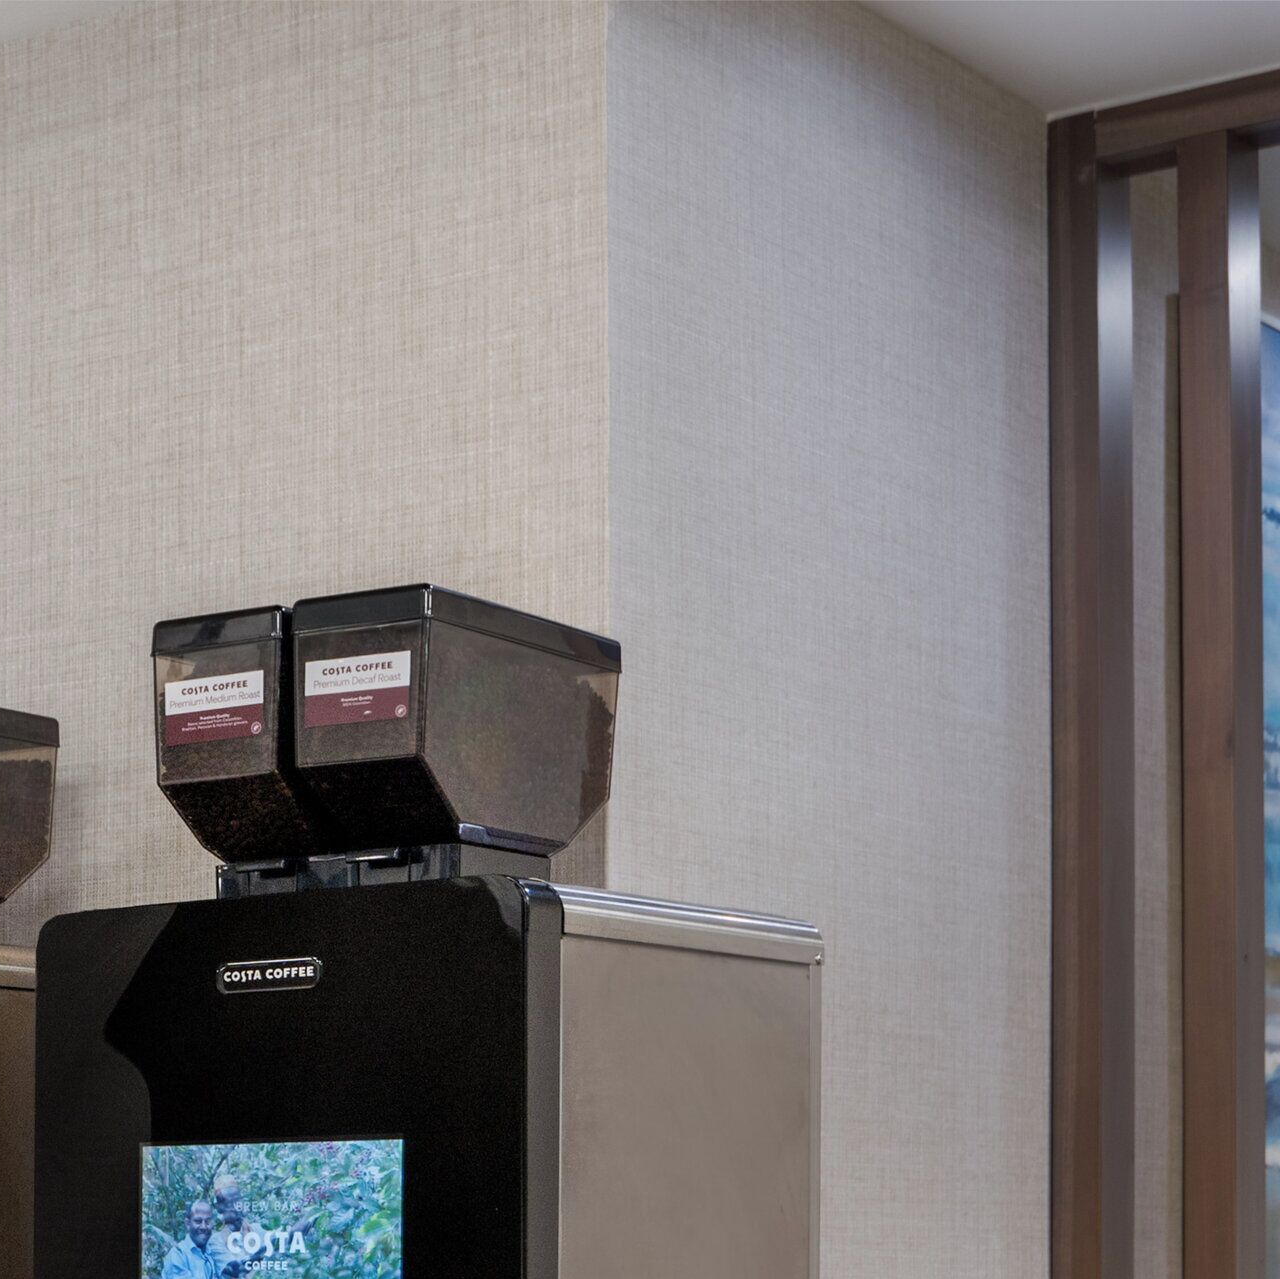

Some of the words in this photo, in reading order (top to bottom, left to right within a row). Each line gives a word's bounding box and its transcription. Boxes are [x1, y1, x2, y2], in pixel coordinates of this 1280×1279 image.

[322, 666, 352, 676] COSTA
[355, 661, 393, 672] COFFEE
[181, 686, 210, 696] COSTA
[212, 680, 248, 692] COFFEE
[313, 678, 350, 689] Premium
[351, 675, 376, 685] Decaf
[377, 673, 401, 682] Roast
[169, 698, 204, 709] Premium
[205, 694, 237, 704] Medium
[238, 690, 261, 700] Roast
[223, 970, 262, 983] COSTA
[265, 966, 315, 980] COFFEE
[226, 1231, 306, 1257] COSTA
[244, 1261, 289, 1271] COFFEE
